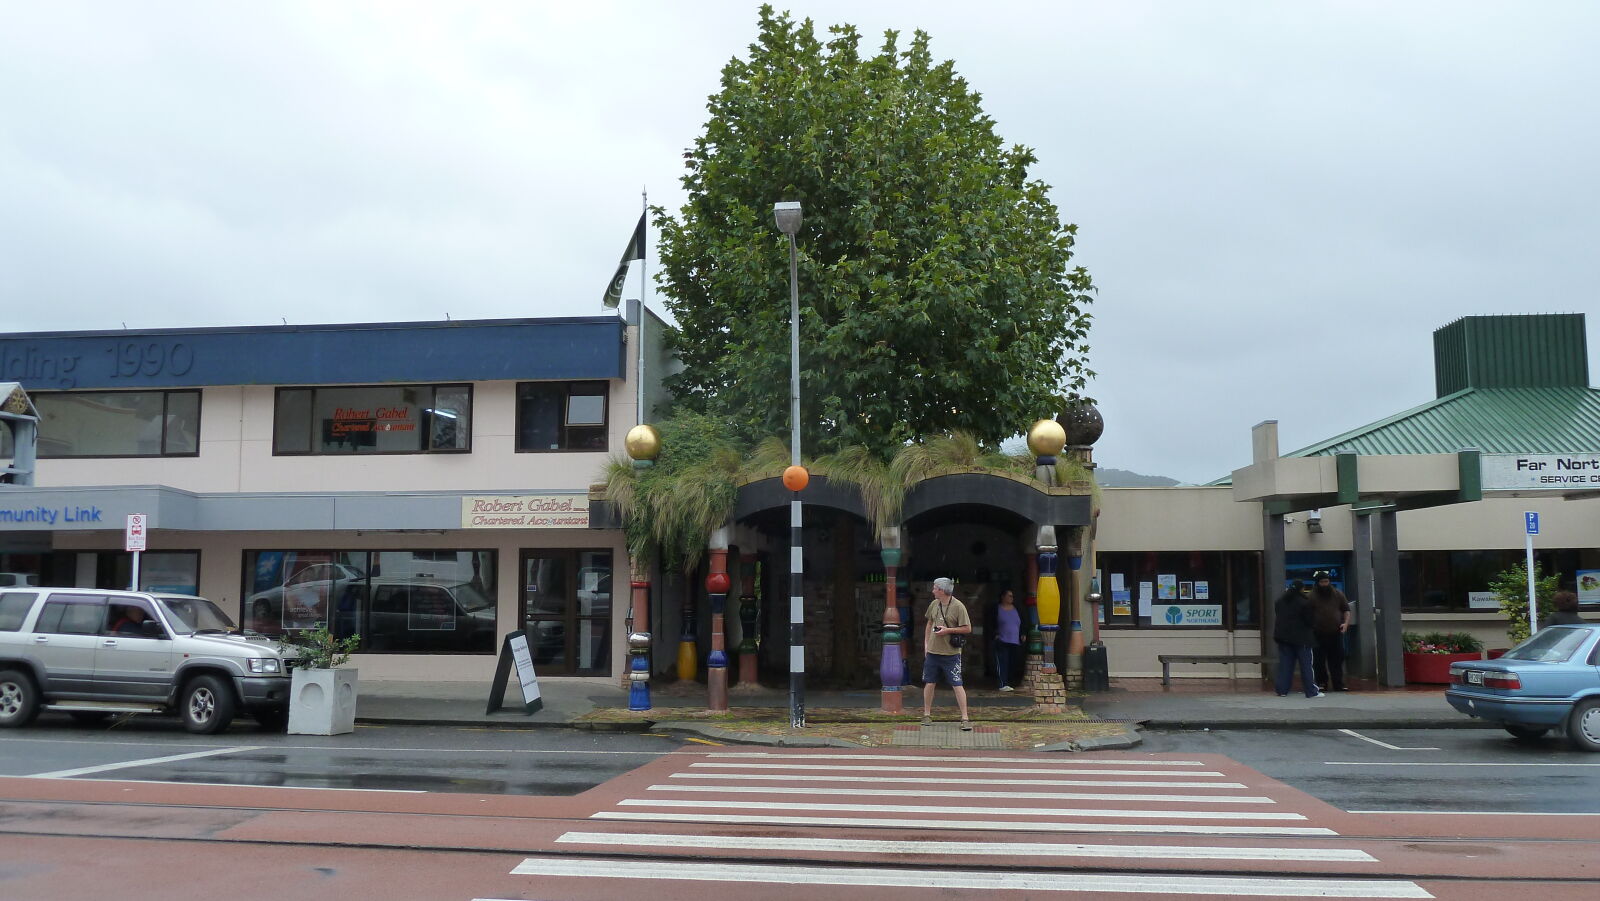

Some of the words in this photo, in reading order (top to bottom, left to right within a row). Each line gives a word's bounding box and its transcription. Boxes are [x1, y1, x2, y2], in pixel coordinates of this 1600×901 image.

[106, 342, 195, 378] 1990
[375, 407, 408, 419] Gabel
[1517, 459, 1547, 471] Far
[1557, 458, 1600, 470] Nort
[1540, 475, 1586, 483] SERVICE
[472, 499, 523, 512] Robert
[527, 498, 573, 512] Gabel
[0, 506, 58, 524] munity
[64, 506, 102, 522] Link
[472, 515, 525, 526] Chartered
[1529, 513, 1535, 521] P
[1186, 608, 1218, 617] SPORT
